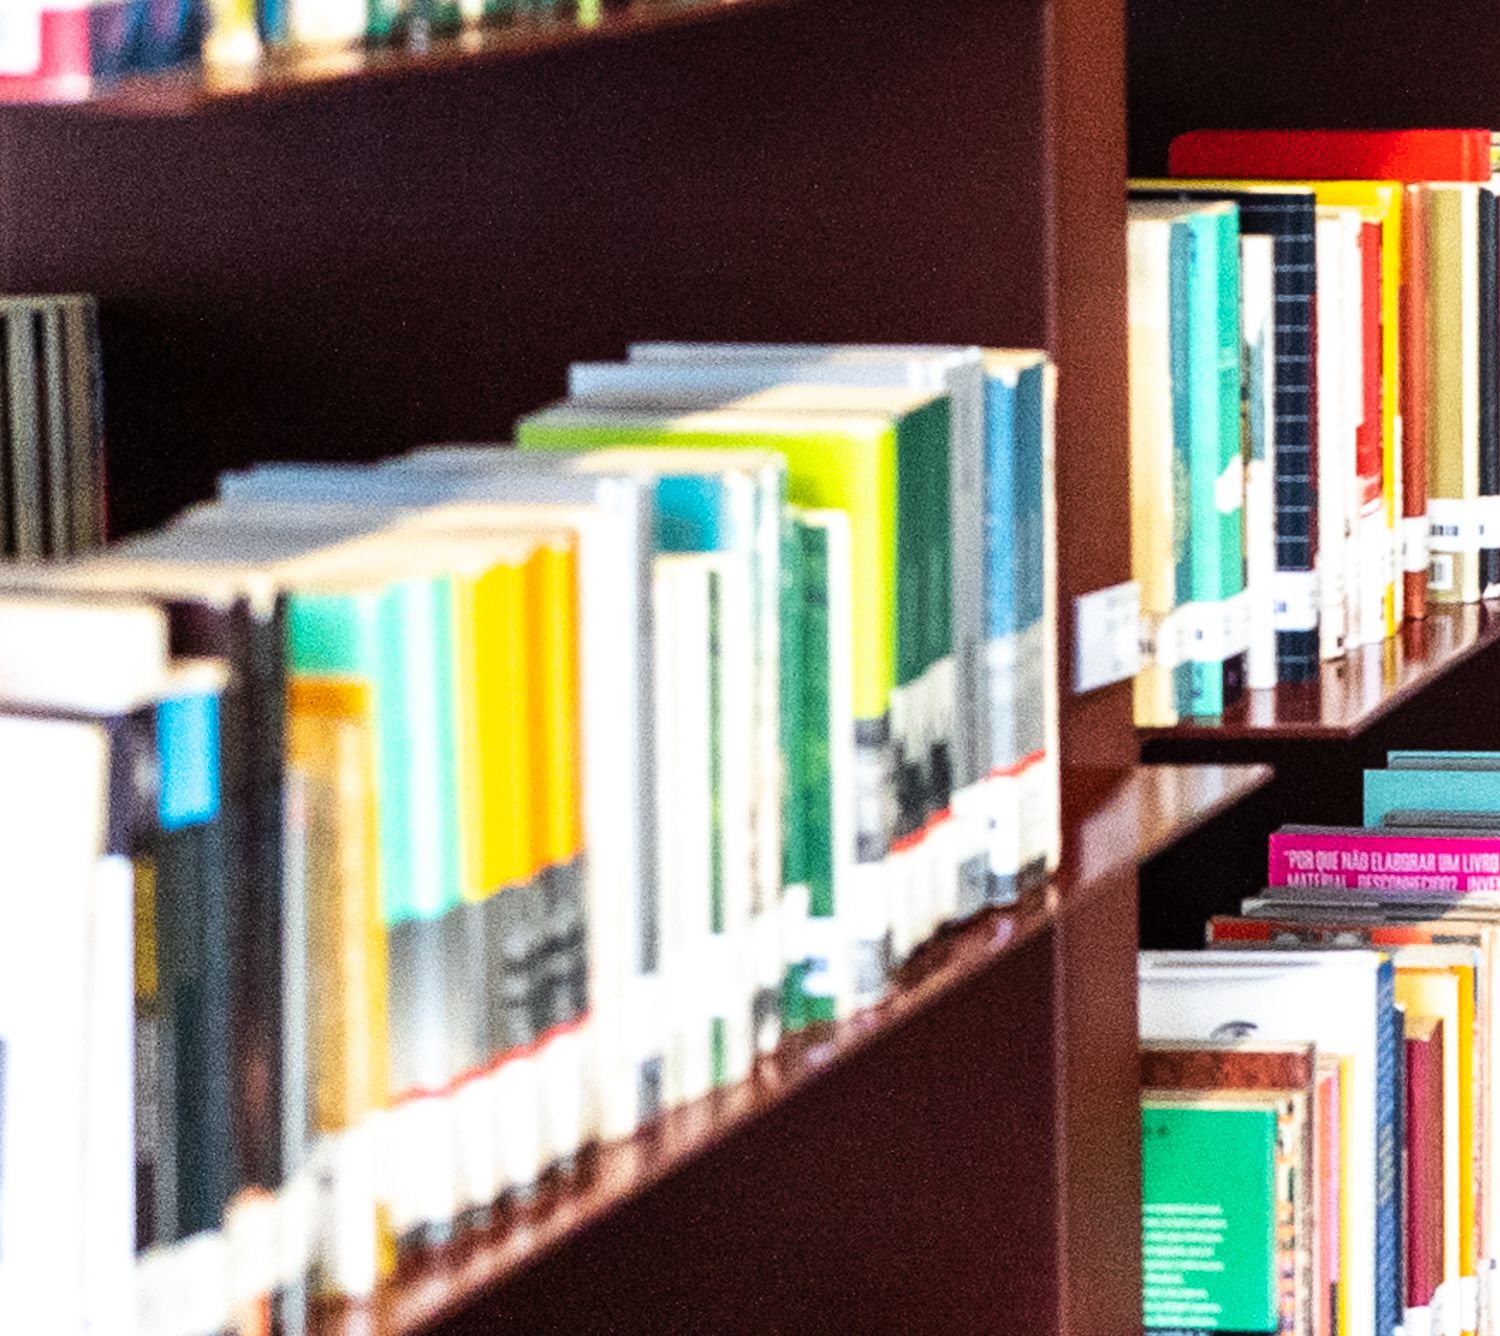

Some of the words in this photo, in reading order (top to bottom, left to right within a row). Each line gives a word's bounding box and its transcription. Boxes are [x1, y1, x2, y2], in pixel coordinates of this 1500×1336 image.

[1315, 850, 1339, 874] QUE
[1341, 847, 1369, 872] NÃO
[1370, 851, 1437, 873] ELABORAR
[1438, 852, 1460, 873] UM
[1462, 853, 1499, 874] LIVRO
